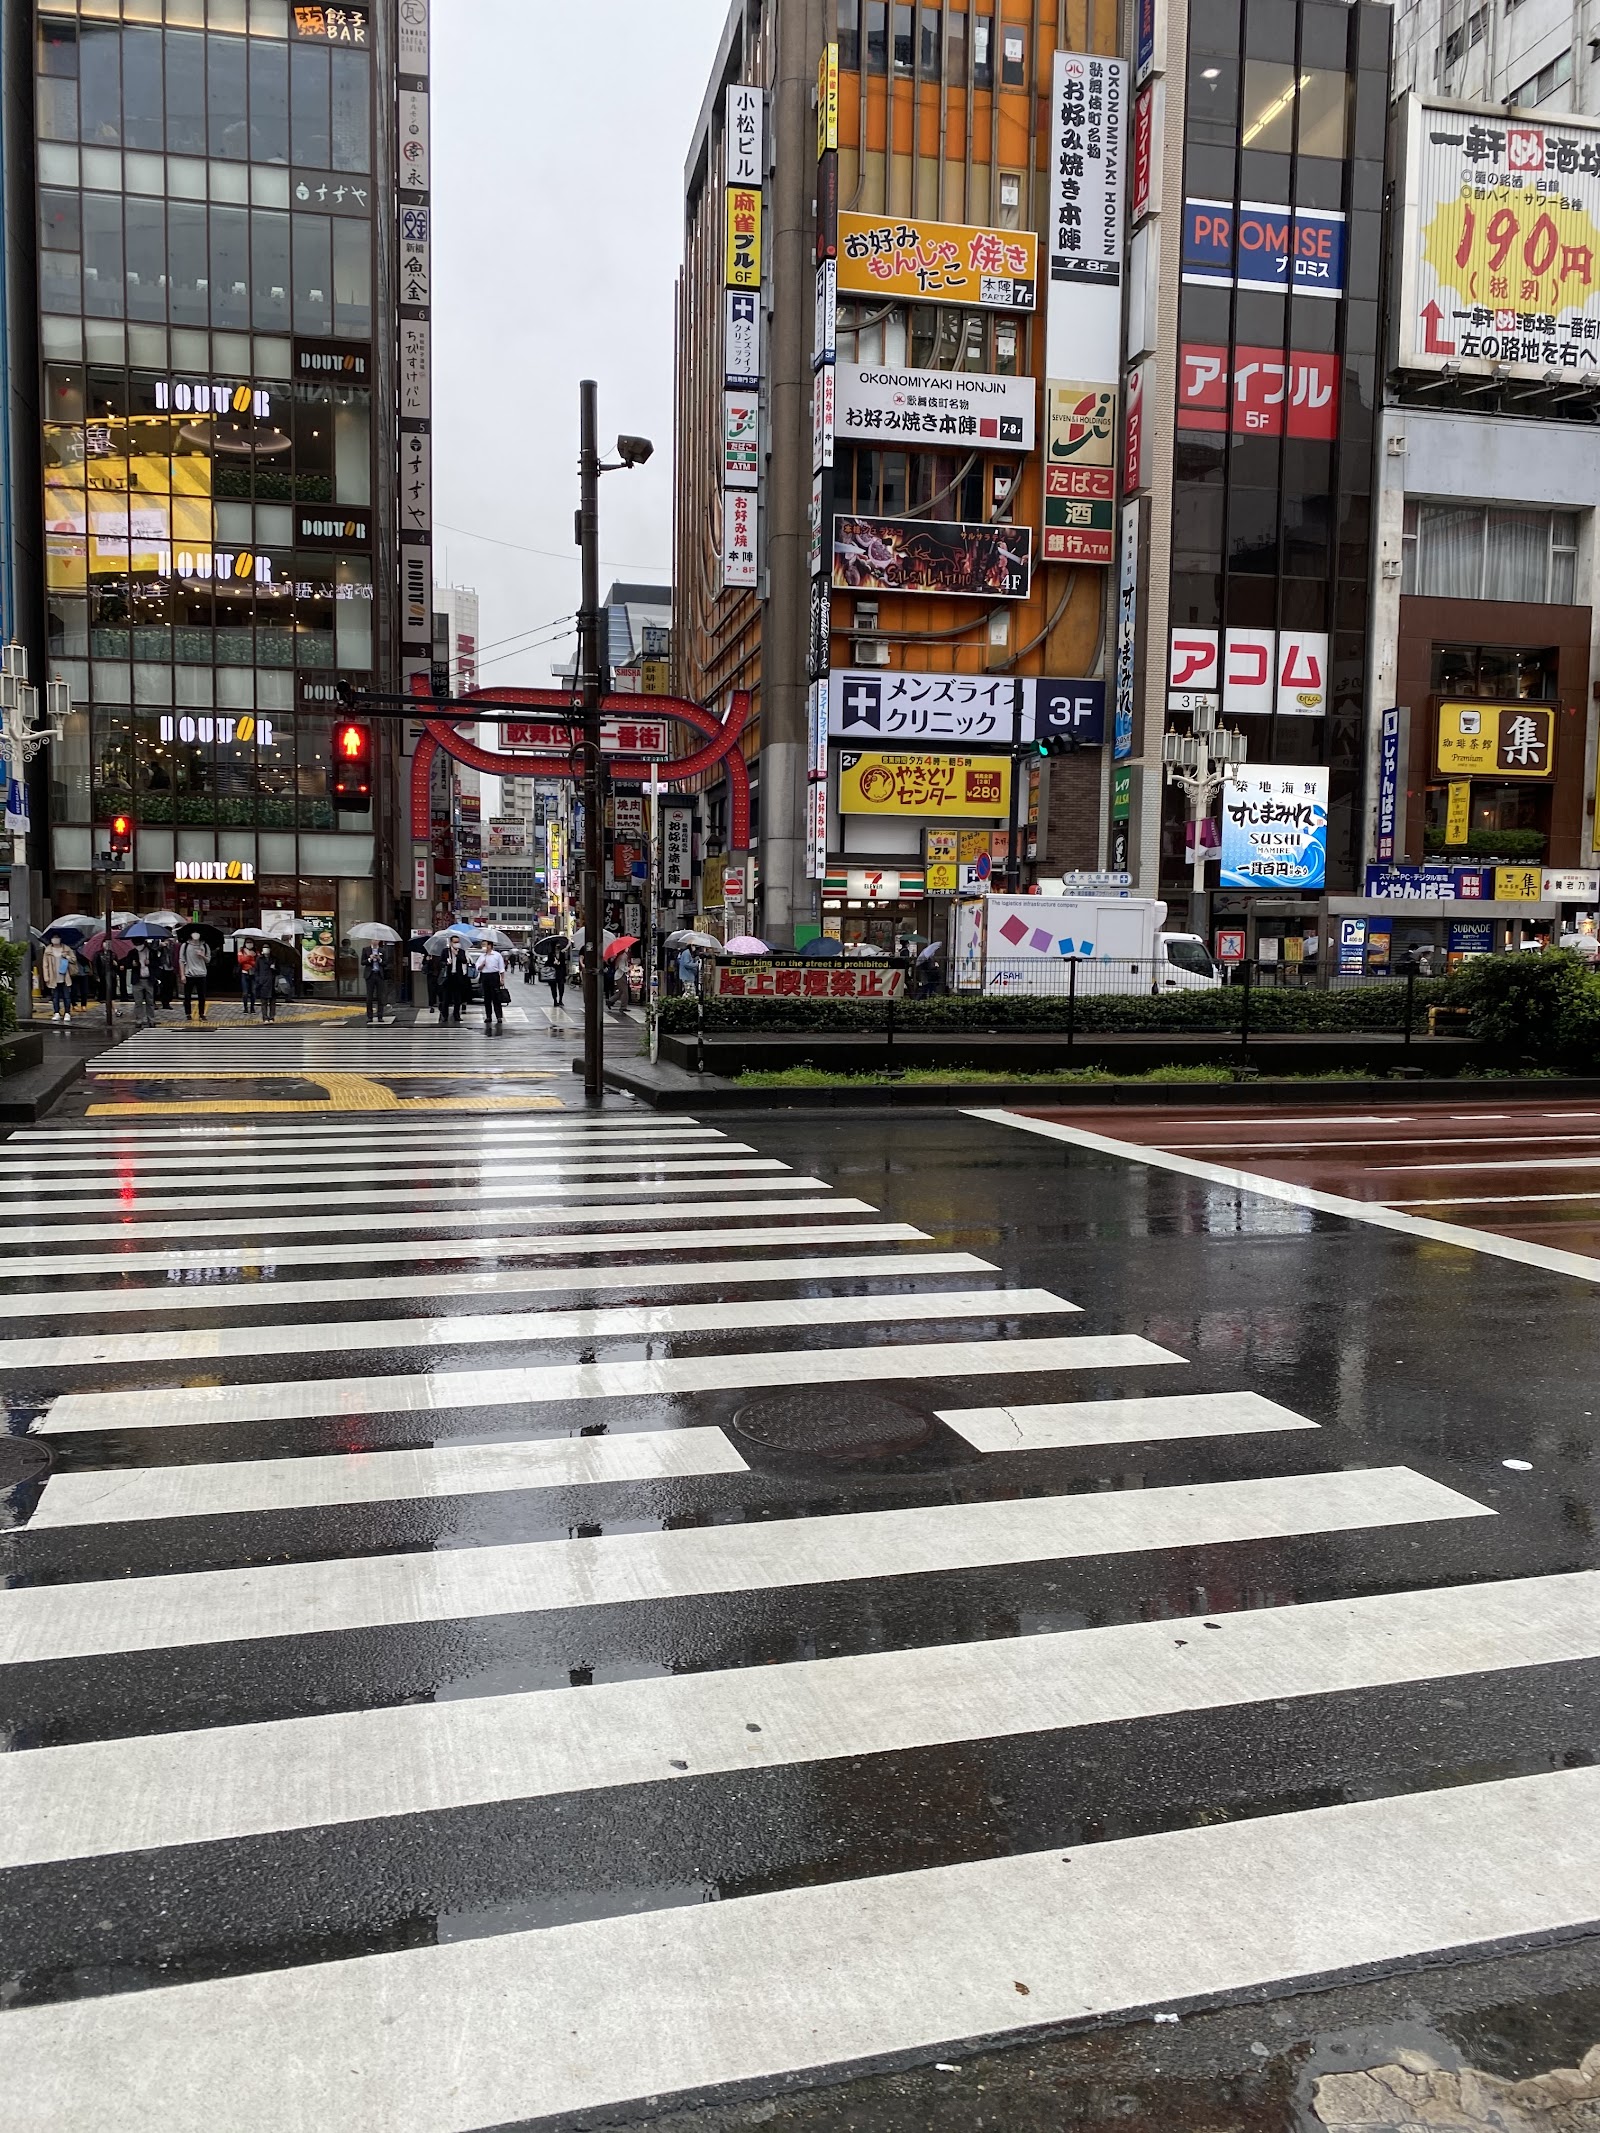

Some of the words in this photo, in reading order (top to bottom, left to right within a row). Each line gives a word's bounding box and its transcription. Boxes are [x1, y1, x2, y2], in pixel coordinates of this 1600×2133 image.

[324, 7, 366, 27] 餃子
[327, 25, 366, 43] BAR
[1141, 61, 1150, 79] 6F
[416, 81, 424, 92] 8
[1086, 61, 1104, 159] 歌舞伎町名物
[736, 92, 755, 178] 小松ビル
[1105, 63, 1121, 187] OKONOMIYAKI
[1058, 79, 1086, 251] お好み焼き本陣
[1137, 117, 1150, 202] アイフル
[1536, 178, 1560, 193] 白鶴
[417, 194, 424, 205] 7
[733, 192, 755, 269] 麻雀ブル
[1103, 191, 1117, 256] HONJIN
[844, 225, 920, 258] お好み
[1193, 215, 1333, 259] PROMISE
[1455, 203, 1594, 286] 190円
[406, 243, 425, 255] 新橋
[968, 232, 1029, 274] 焼き
[868, 241, 959, 280] もんじゃ
[1275, 255, 1330, 278] プロミス
[404, 256, 428, 301] 魚金
[734, 271, 752, 284] 6F
[916, 263, 967, 292] たこ
[982, 278, 1012, 294] 本陣
[981, 292, 1012, 302] PART2
[1014, 285, 1033, 303] 7F
[418, 310, 426, 319] 6
[1460, 332, 1599, 368] 左の路地を右へ
[301, 352, 366, 374] DOUTOR
[406, 331, 421, 408] ちびすけバル
[859, 372, 953, 390] OKONOMIYAKI
[956, 380, 1006, 394] HONJIN
[1185, 355, 1333, 408] アイフル
[154, 381, 271, 418] DOUTOR
[906, 395, 970, 411] 歌舞伎町名物
[418, 422, 426, 432] 5
[845, 406, 977, 436] お好み焼き本陣
[1079, 416, 1112, 427] HOLDINGS
[1245, 410, 1270, 429] 5F
[1128, 413, 1139, 474] アコム
[732, 462, 751, 471] ATM
[408, 455, 426, 528] すずや
[1049, 469, 1110, 495] たばこ
[1128, 474, 1137, 489] 3F
[734, 496, 748, 548] お好み焼
[1065, 500, 1094, 526] 酒
[302, 519, 366, 539] DOUTOR
[418, 534, 426, 543] 4
[728, 550, 754, 563] 本陣
[407, 559, 426, 627] DOUTOR
[1000, 574, 1021, 590] 4F
[419, 647, 427, 658] 3
[1173, 640, 1322, 689] アコム
[1048, 695, 1093, 726] 3F
[158, 714, 274, 746] DOUTOR
[886, 708, 997, 736] クリニック
[1502, 715, 1546, 765] 集
[842, 755, 858, 767] 2F
[1451, 753, 1484, 763] Premium
[895, 765, 956, 787] やきとり
[896, 786, 958, 806] センター
[1236, 780, 1318, 795] 築地海鮮
[616, 799, 641, 811] 焼肉
[1115, 792, 1130, 806] ALSA
[1249, 832, 1301, 846] SUSHI
[667, 821, 681, 885] お好み焼本陣
[175, 860, 255, 881] DOUTOR
[1519, 872, 1538, 897] 集
[1343, 923, 1356, 943] P
[1452, 923, 1491, 935] SUBNADE
[730, 957, 773, 968] Smoking
[788, 958, 803, 968] the
[804, 959, 832, 968] street
[833, 959, 842, 968] is
[843, 959, 892, 970] prohibited.
